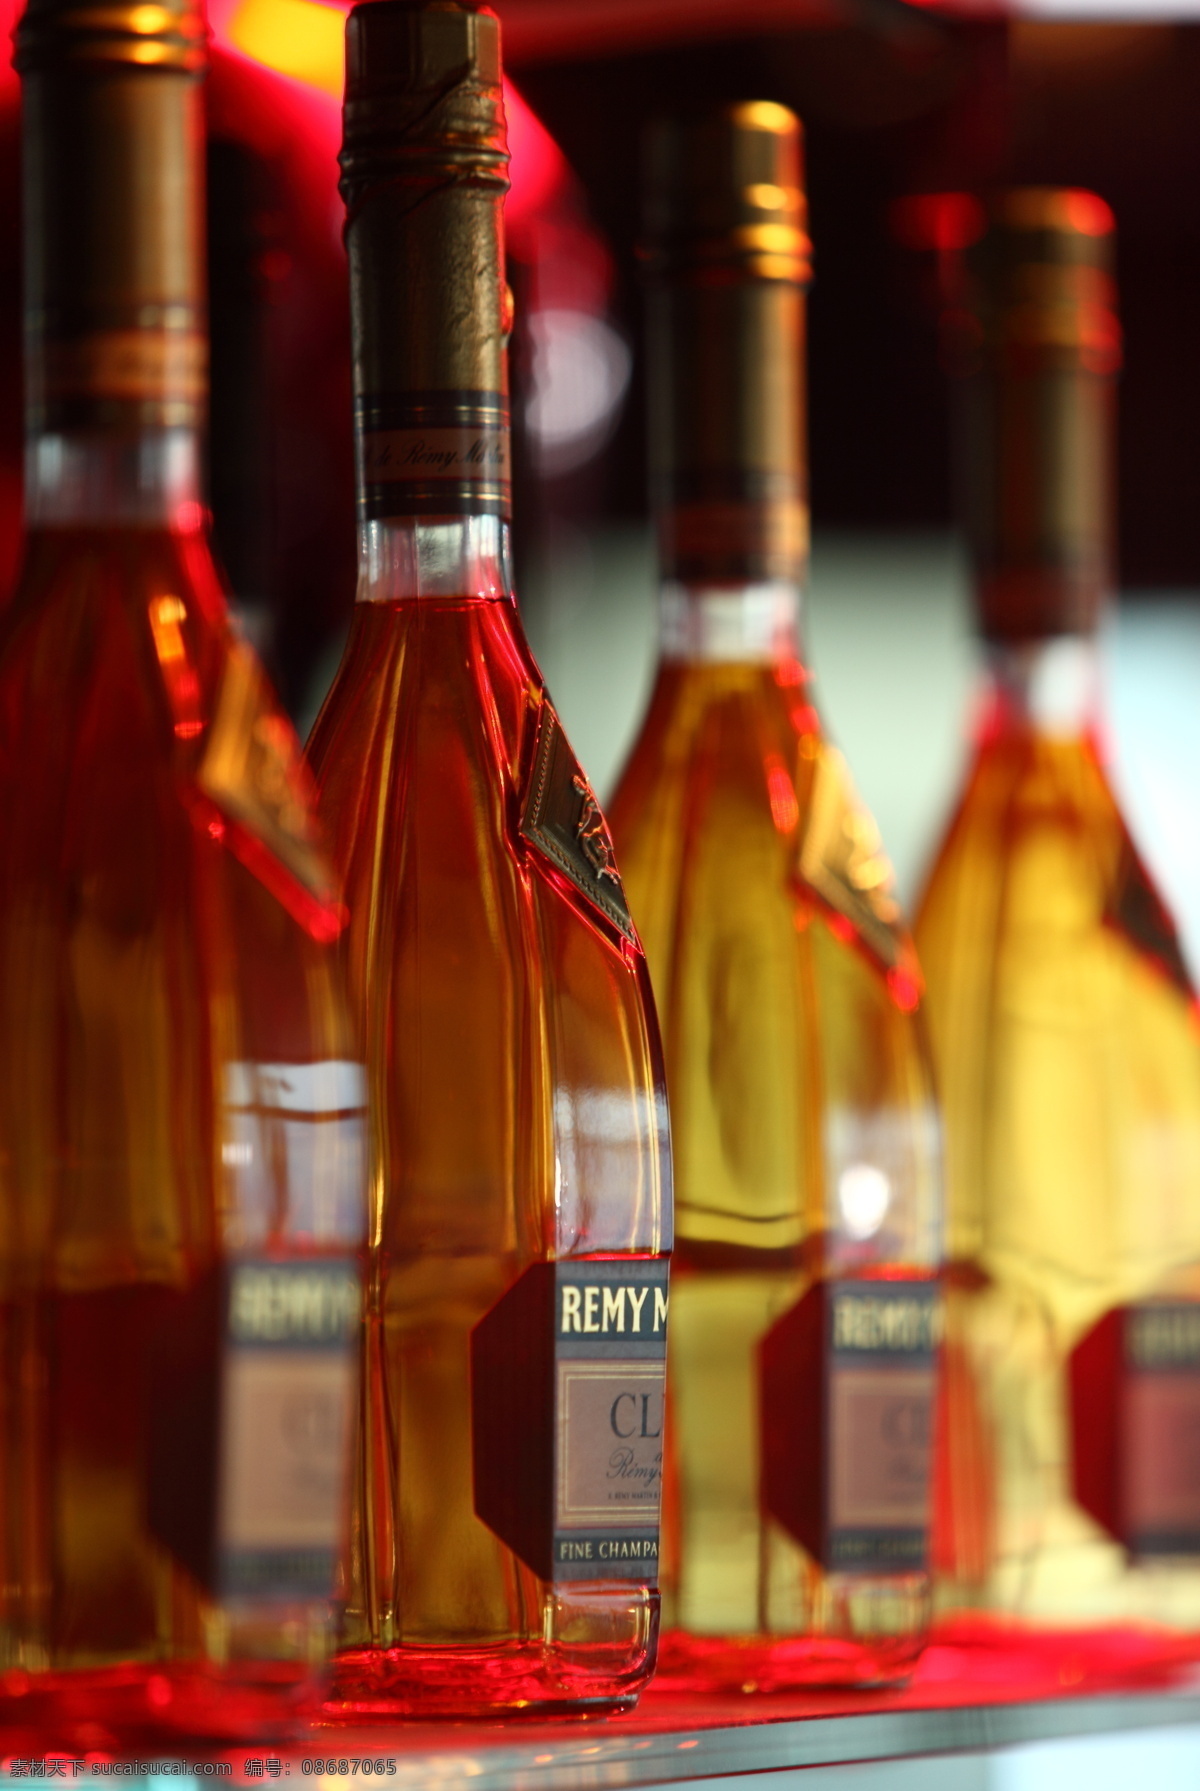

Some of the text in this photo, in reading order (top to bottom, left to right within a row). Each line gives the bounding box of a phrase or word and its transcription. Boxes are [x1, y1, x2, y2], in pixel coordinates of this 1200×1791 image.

[561, 1285, 649, 1333] REMY
[610, 1392, 661, 1439] CL
[606, 1446, 658, 1488] Rémy
[560, 1540, 658, 1560] FINE CHAMPA
